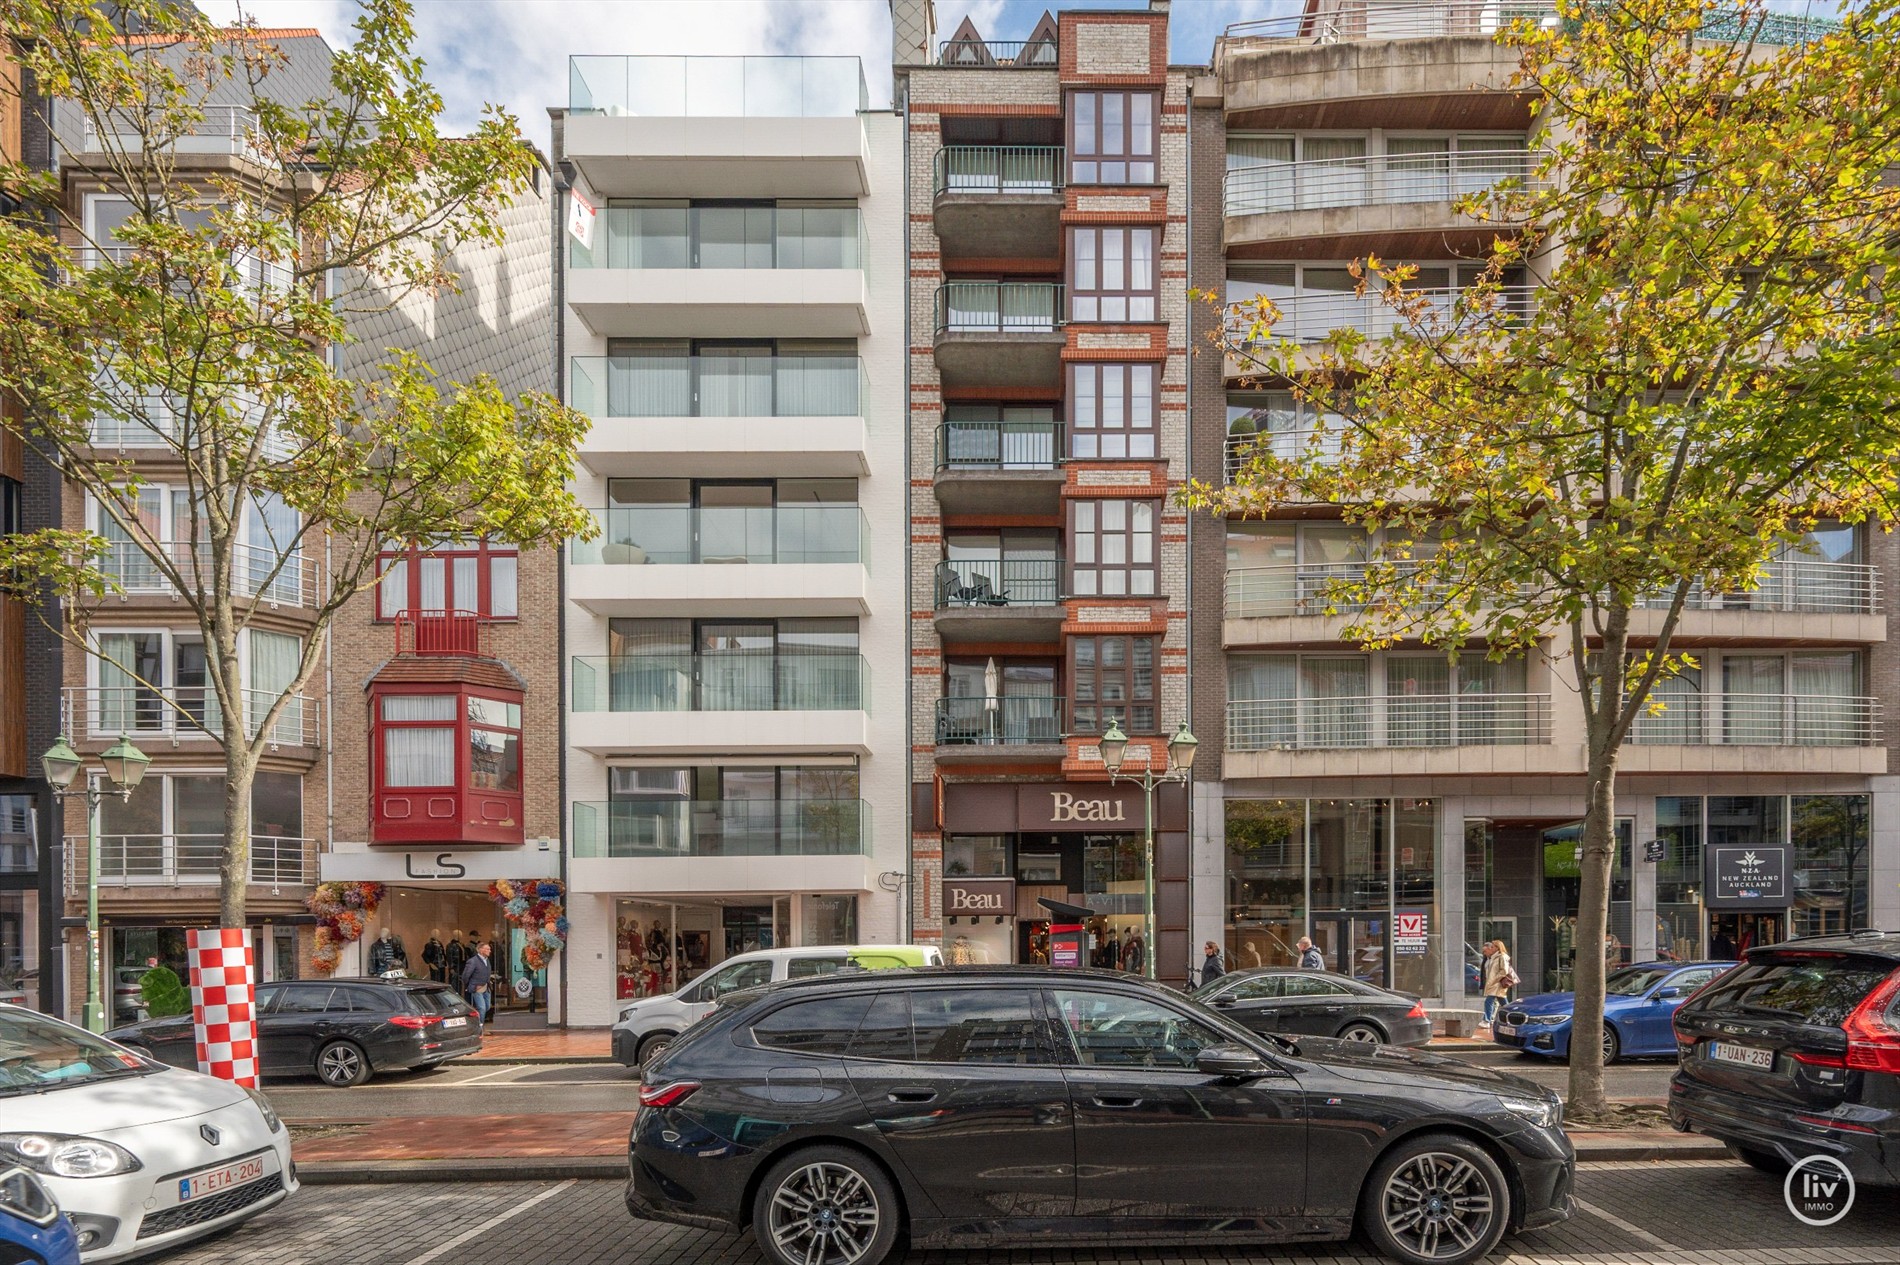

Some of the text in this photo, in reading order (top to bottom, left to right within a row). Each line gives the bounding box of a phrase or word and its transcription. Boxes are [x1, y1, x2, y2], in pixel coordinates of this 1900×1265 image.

[1050, 792, 1126, 822] Beau
[406, 853, 466, 879] LS
[951, 888, 1003, 909] Beau
[1717, 1045, 1772, 1066] 1-UAN-236
[192, 1160, 261, 1194] 1-ETA-204
